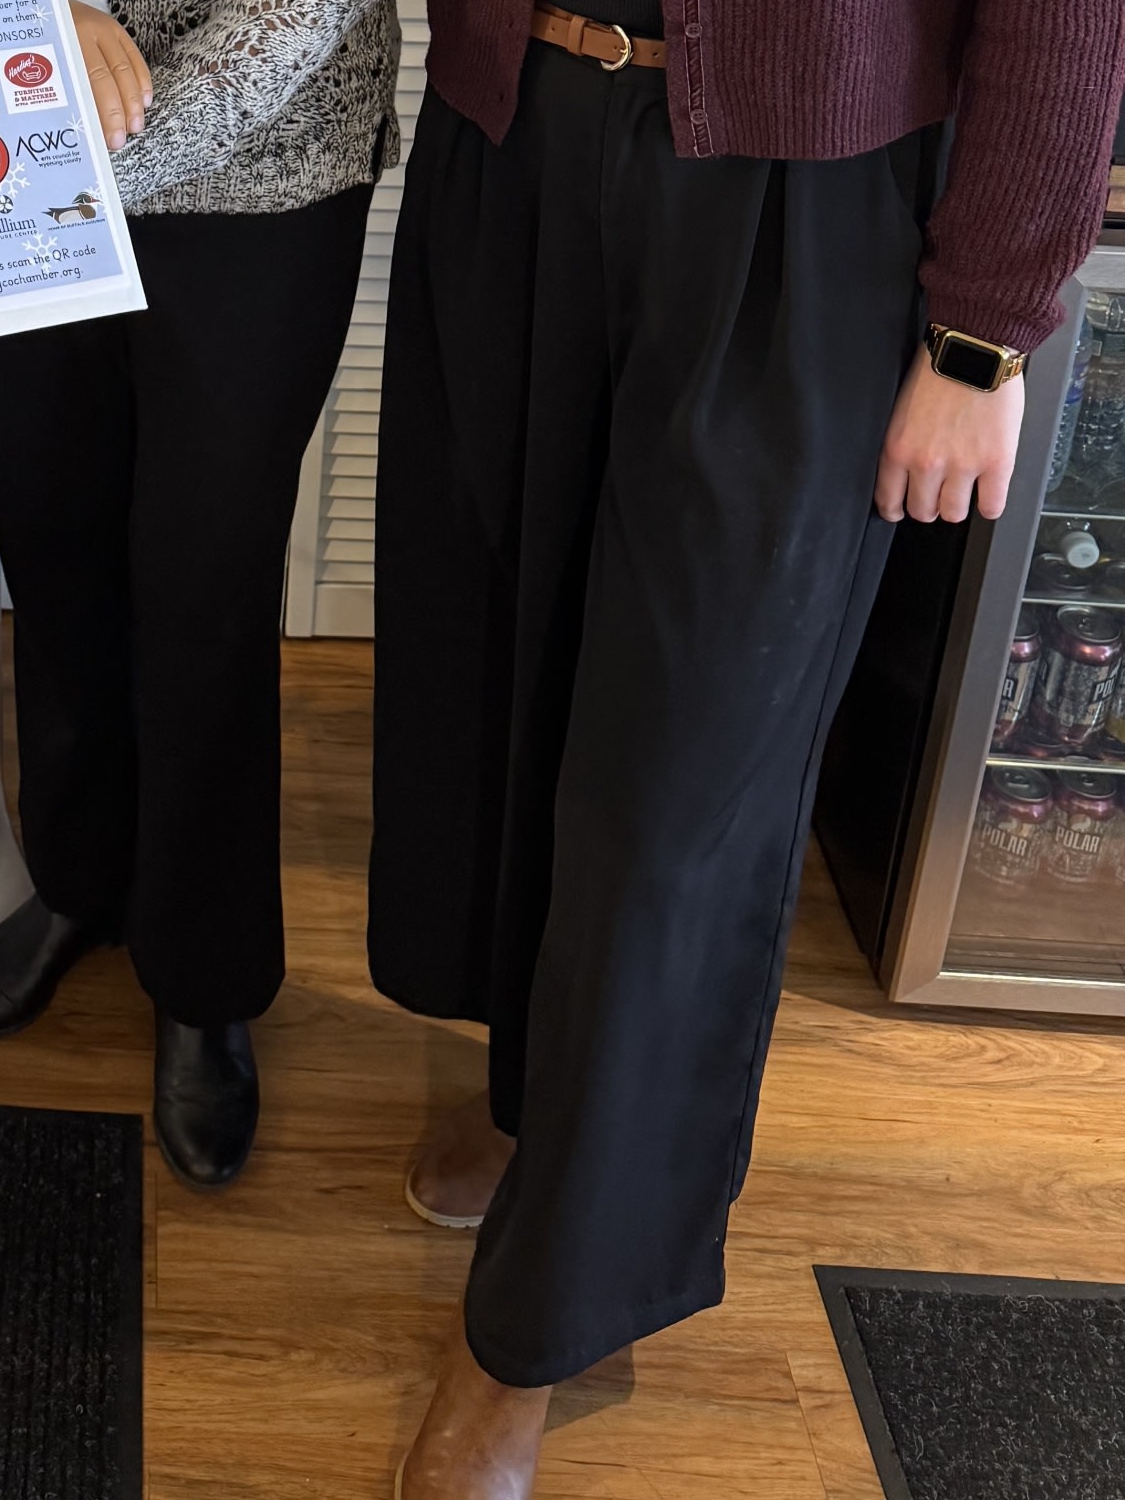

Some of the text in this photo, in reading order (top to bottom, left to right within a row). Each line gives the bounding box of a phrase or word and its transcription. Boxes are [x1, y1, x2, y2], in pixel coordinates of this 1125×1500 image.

[2, 15, 14, 23] on
[14, 86, 54, 97] FURNITURE
[15, 128, 78, 162] ACWC
[14, 230, 38, 239] CENTER
[7, 257, 32, 269] scan
[33, 252, 50, 264] the
[52, 247, 71, 260] QR
[72, 245, 97, 258] code
[981, 823, 1028, 856] POLAR
[1055, 826, 1100, 853] POLAR
